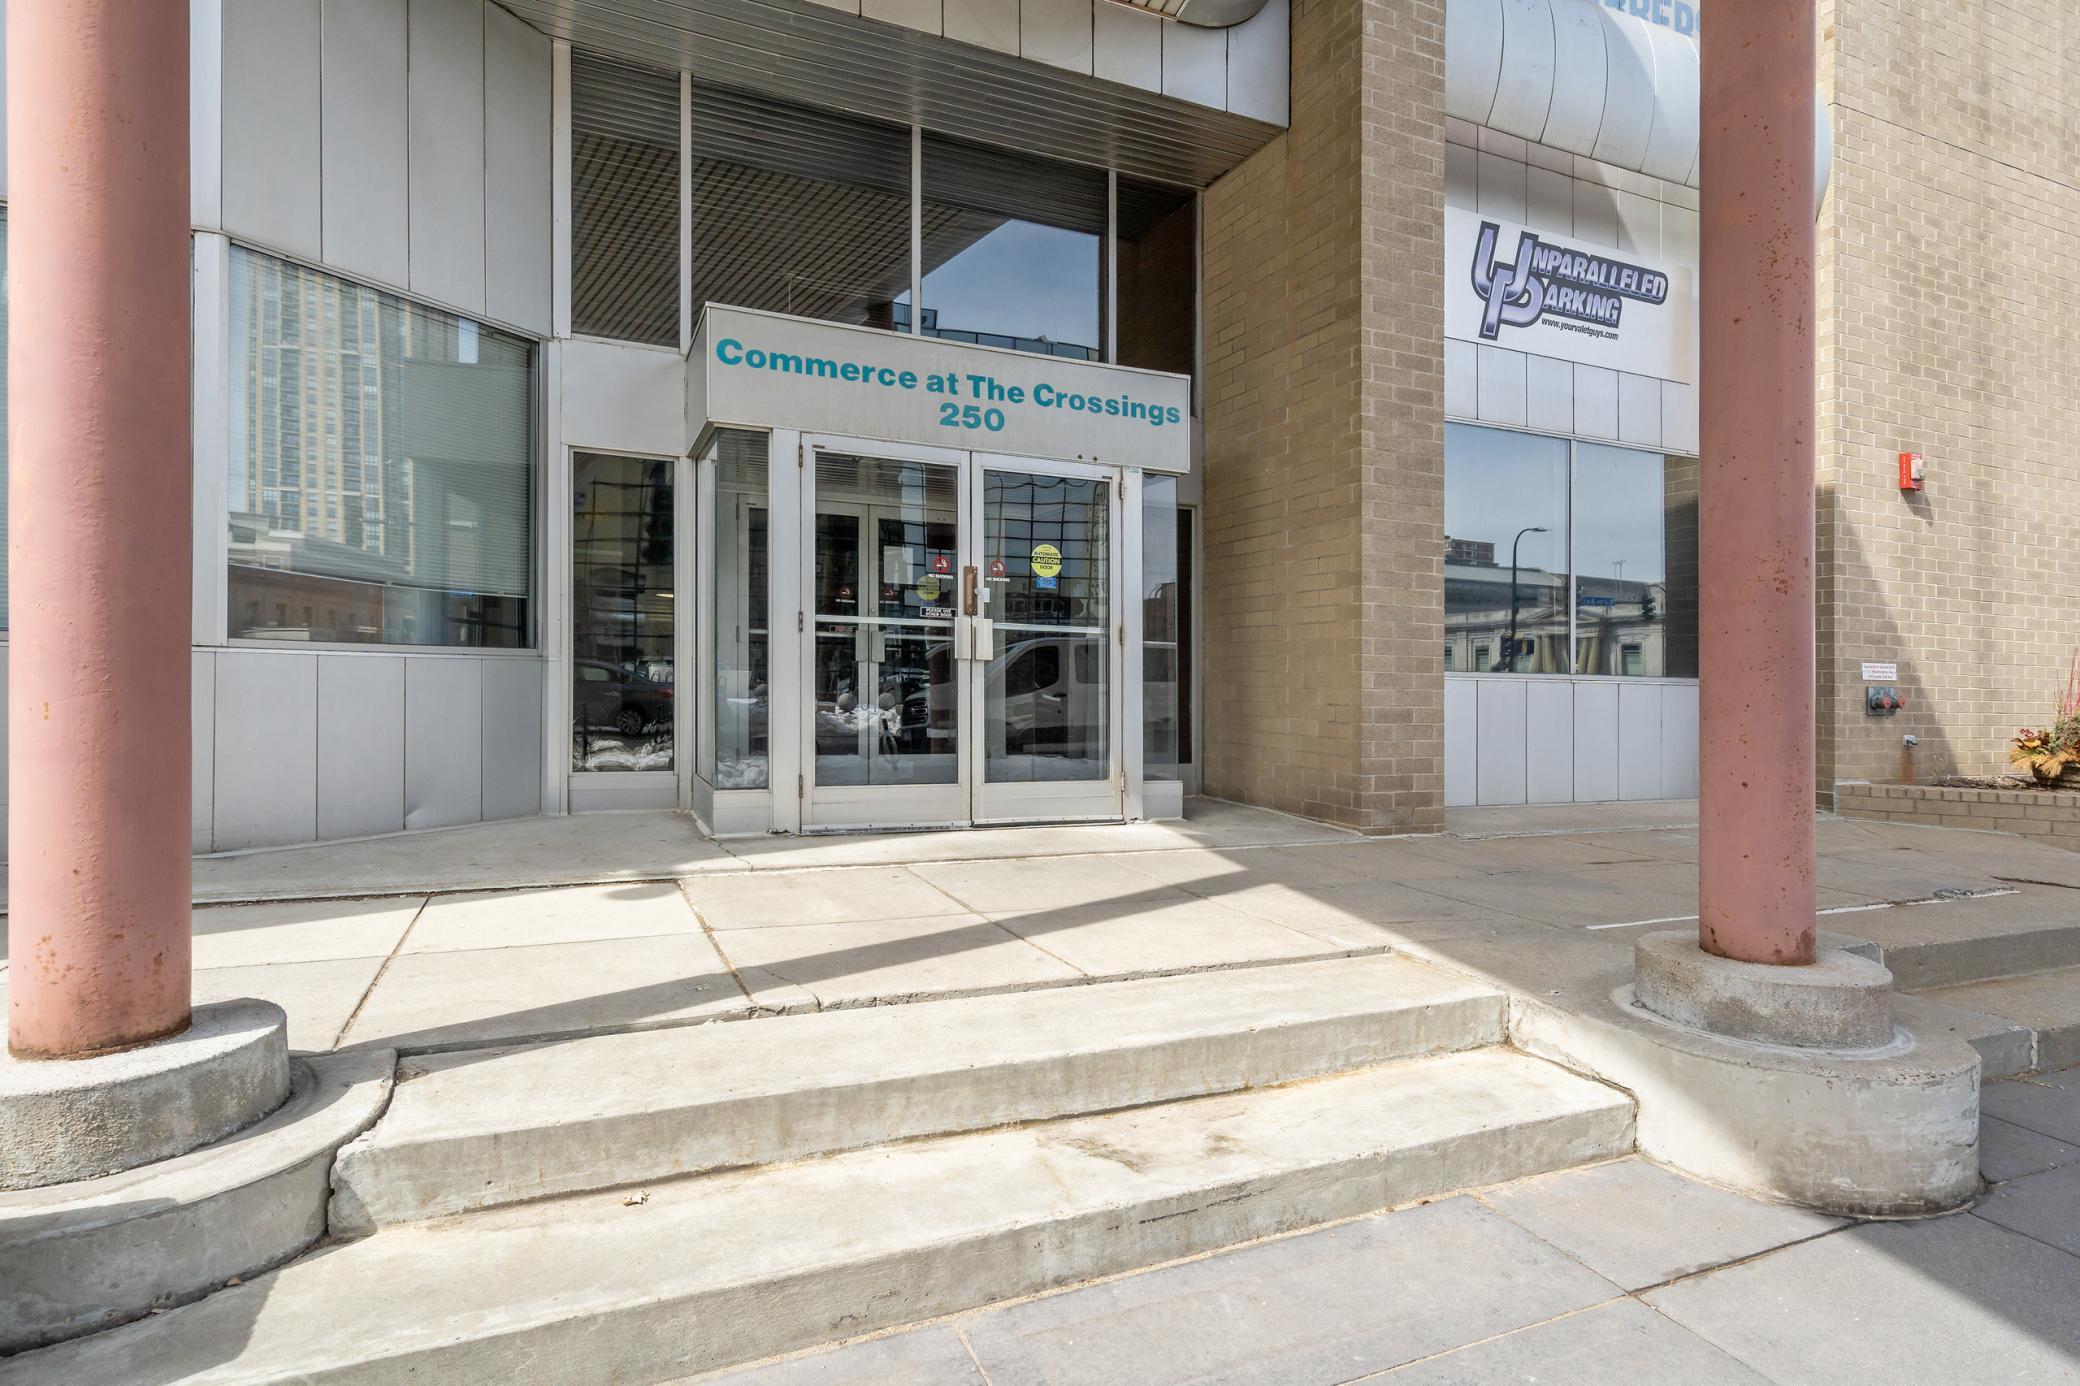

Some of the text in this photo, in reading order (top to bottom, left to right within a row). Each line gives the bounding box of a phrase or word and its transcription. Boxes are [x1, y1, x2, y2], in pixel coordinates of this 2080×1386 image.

[1471, 220, 1668, 305] UNPARALLELED
[1479, 261, 1622, 341] PARKING
[1541, 317, 1619, 341] www.yourvaletguys.com
[715, 338, 1181, 427] Commerce at The Crossings
[940, 402, 1005, 433] 250
[1032, 557, 1060, 565] CAUTION
